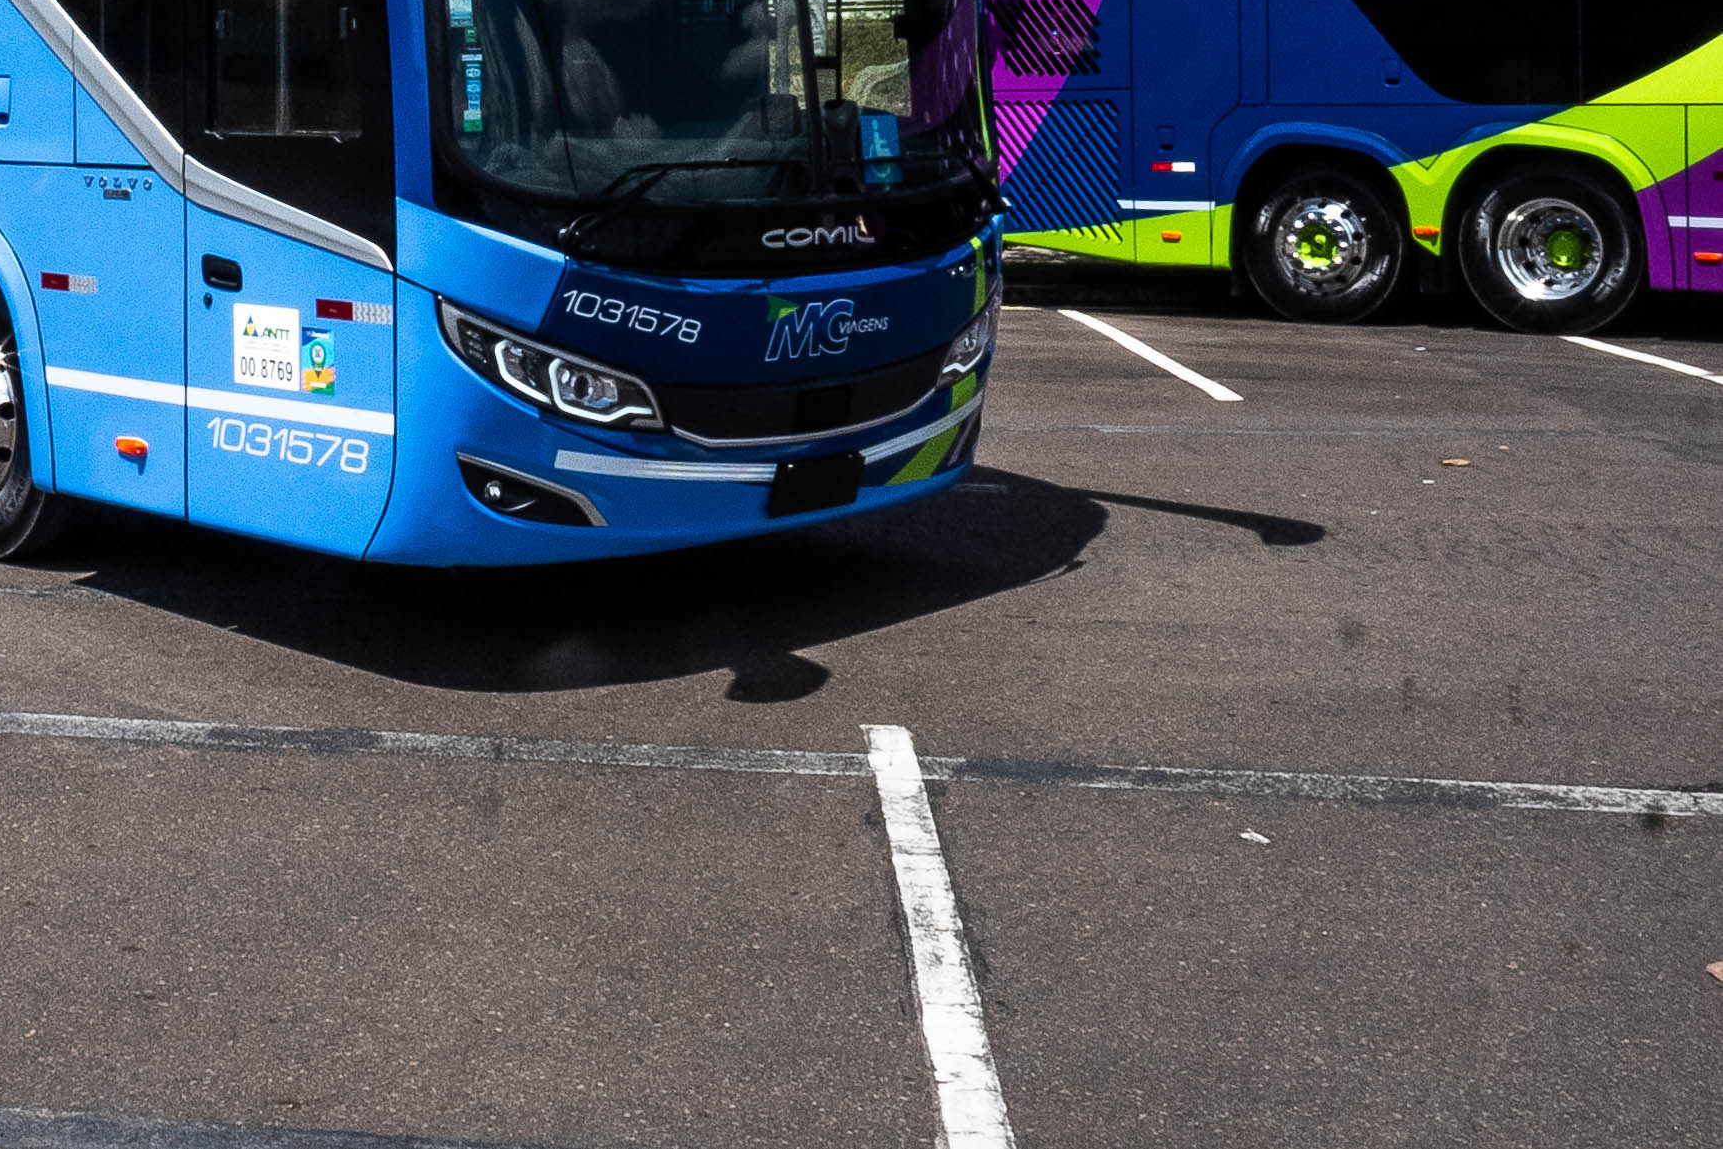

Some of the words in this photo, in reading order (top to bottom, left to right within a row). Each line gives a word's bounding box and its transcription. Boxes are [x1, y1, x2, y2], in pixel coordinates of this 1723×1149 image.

[83, 175, 153, 191] VOLVO
[761, 225, 876, 249] COMIL
[563, 289, 702, 343] 1031578
[261, 327, 290, 341] ANTT
[764, 298, 855, 362] MC
[839, 316, 890, 335] VIAGENS
[240, 356, 293, 382] 00.8769
[207, 416, 370, 474] 1031578
